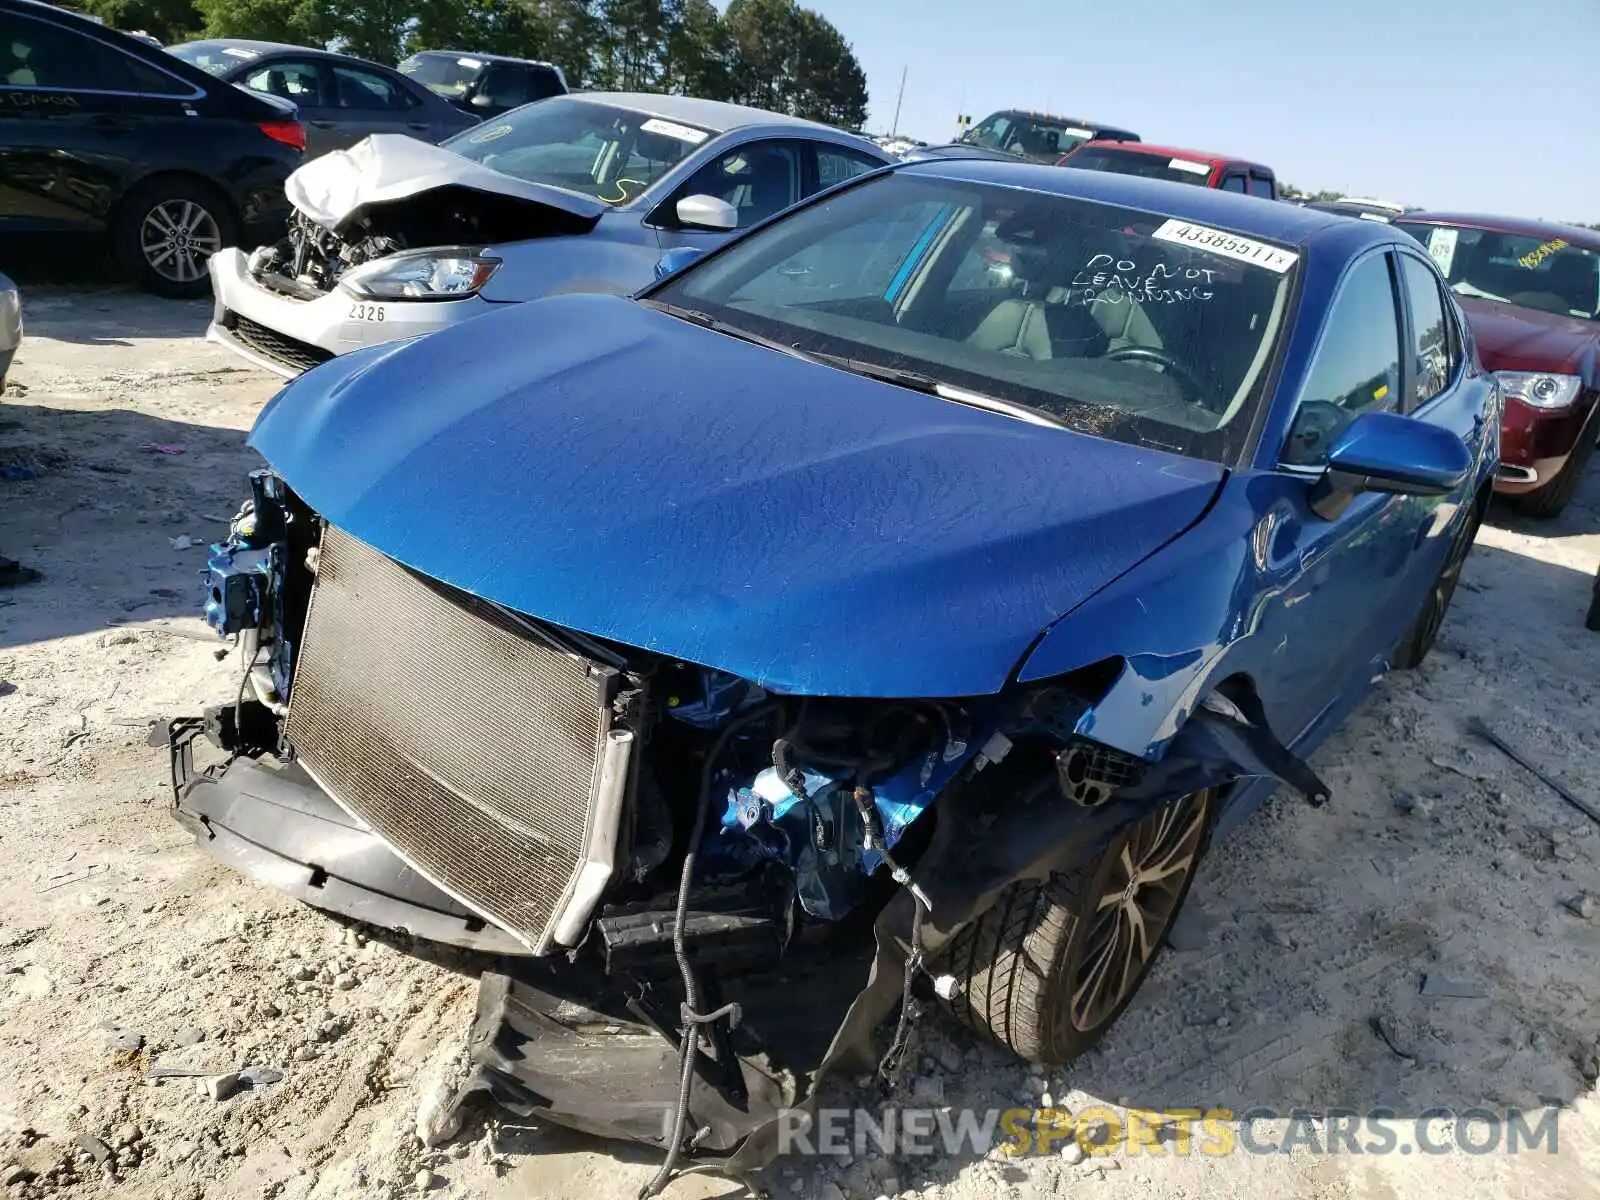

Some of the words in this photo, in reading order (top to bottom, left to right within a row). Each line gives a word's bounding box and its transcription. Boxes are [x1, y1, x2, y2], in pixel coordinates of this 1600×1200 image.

[1086, 254, 1136, 271] DO
[1151, 263, 1225, 284] NOT
[1072, 271, 1158, 290] LEAVE
[1082, 286, 1215, 305] RUNNING
[348, 303, 385, 322] 2326
